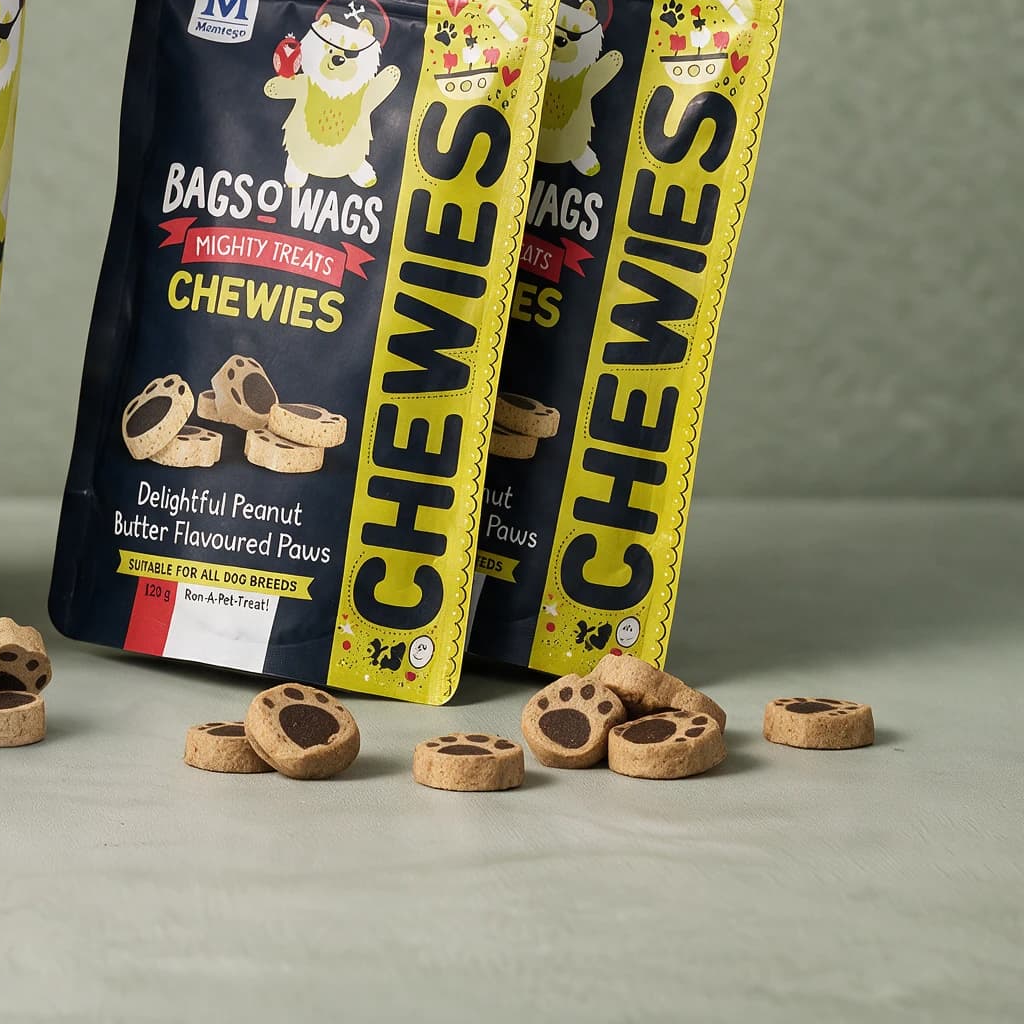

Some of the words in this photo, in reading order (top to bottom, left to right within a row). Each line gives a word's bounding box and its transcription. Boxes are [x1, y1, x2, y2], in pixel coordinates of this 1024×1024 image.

[162, 162, 254, 219] BAGS
[290, 186, 383, 244] WAGS
[196, 235, 268, 257] MIGHTY
[274, 241, 334, 276] TREATS
[168, 270, 345, 333] CHEWIES
[353, 100, 511, 631] CHEWIES
[560, 84, 738, 611] CHEWIES
[137, 480, 226, 516] Delightful
[232, 493, 303, 526] Peanut
[114, 511, 168, 542] Butter
[174, 521, 273, 556] Flavoured
[277, 534, 331, 564] Paws
[486, 514, 537, 548] Paws
[128, 558, 172, 576] SUITABLE
[176, 565, 197, 579] FOR
[201, 569, 220, 582] ALL
[224, 573, 246, 585] DOG
[250, 576, 297, 592] BREEDS
[144, 583, 162, 597] 120
[164, 590, 170, 602] g
[184, 588, 270, 612] Ron-A-Pet-Treat!
